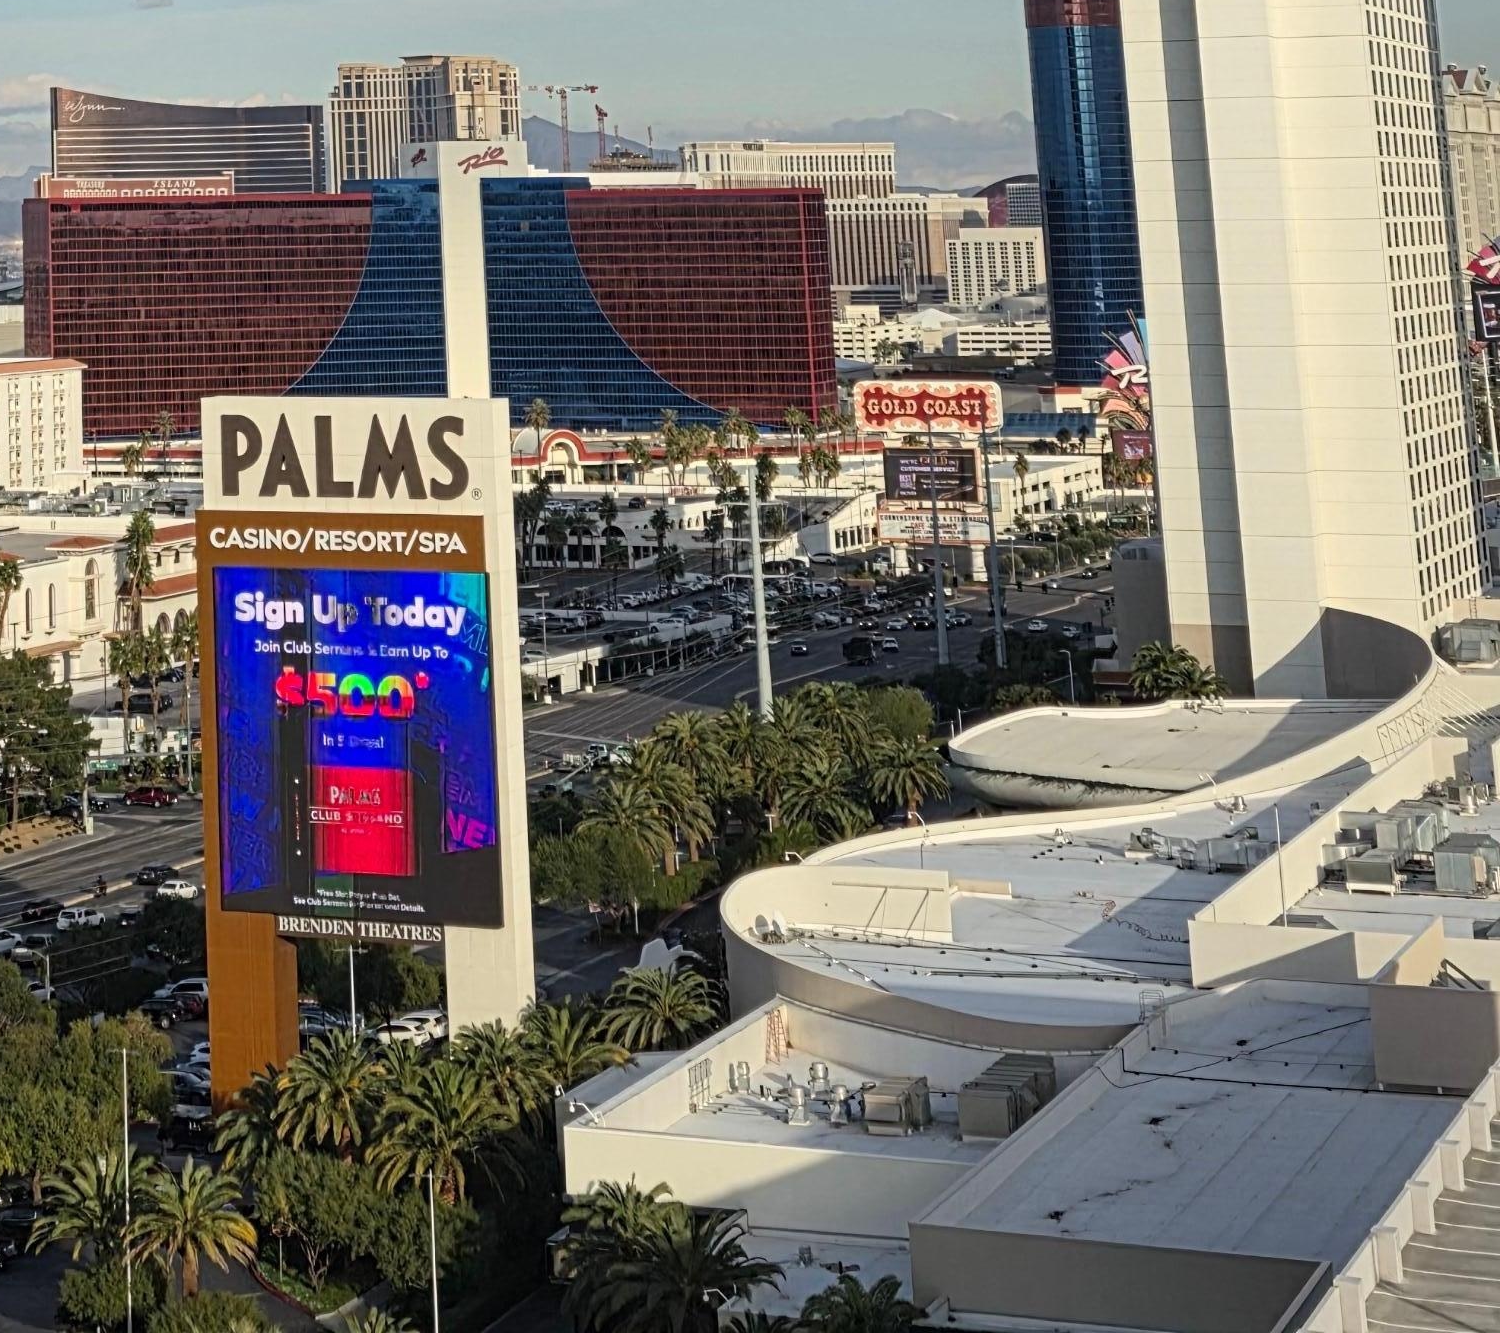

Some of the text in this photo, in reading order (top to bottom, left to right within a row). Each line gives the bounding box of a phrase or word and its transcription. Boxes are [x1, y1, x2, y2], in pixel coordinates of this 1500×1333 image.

[458, 146, 508, 174] Rio
[153, 180, 196, 188] ISLAND
[867, 399, 982, 416] GOLD COAST
[220, 413, 470, 501] PALMS
[210, 528, 467, 555] CASINO/RESORT/SPA
[234, 591, 467, 636] Sign Up Today
[255, 639, 281, 654] Join
[283, 640, 312, 655] Club
[380, 645, 409, 658] Earn
[412, 645, 431, 660] Up
[433, 646, 449, 660] To
[323, 734, 334, 747] In
[310, 810, 341, 821] CLUB
[307, 897, 322, 906] Club
[279, 915, 442, 942] BRENDEN THEATRES
